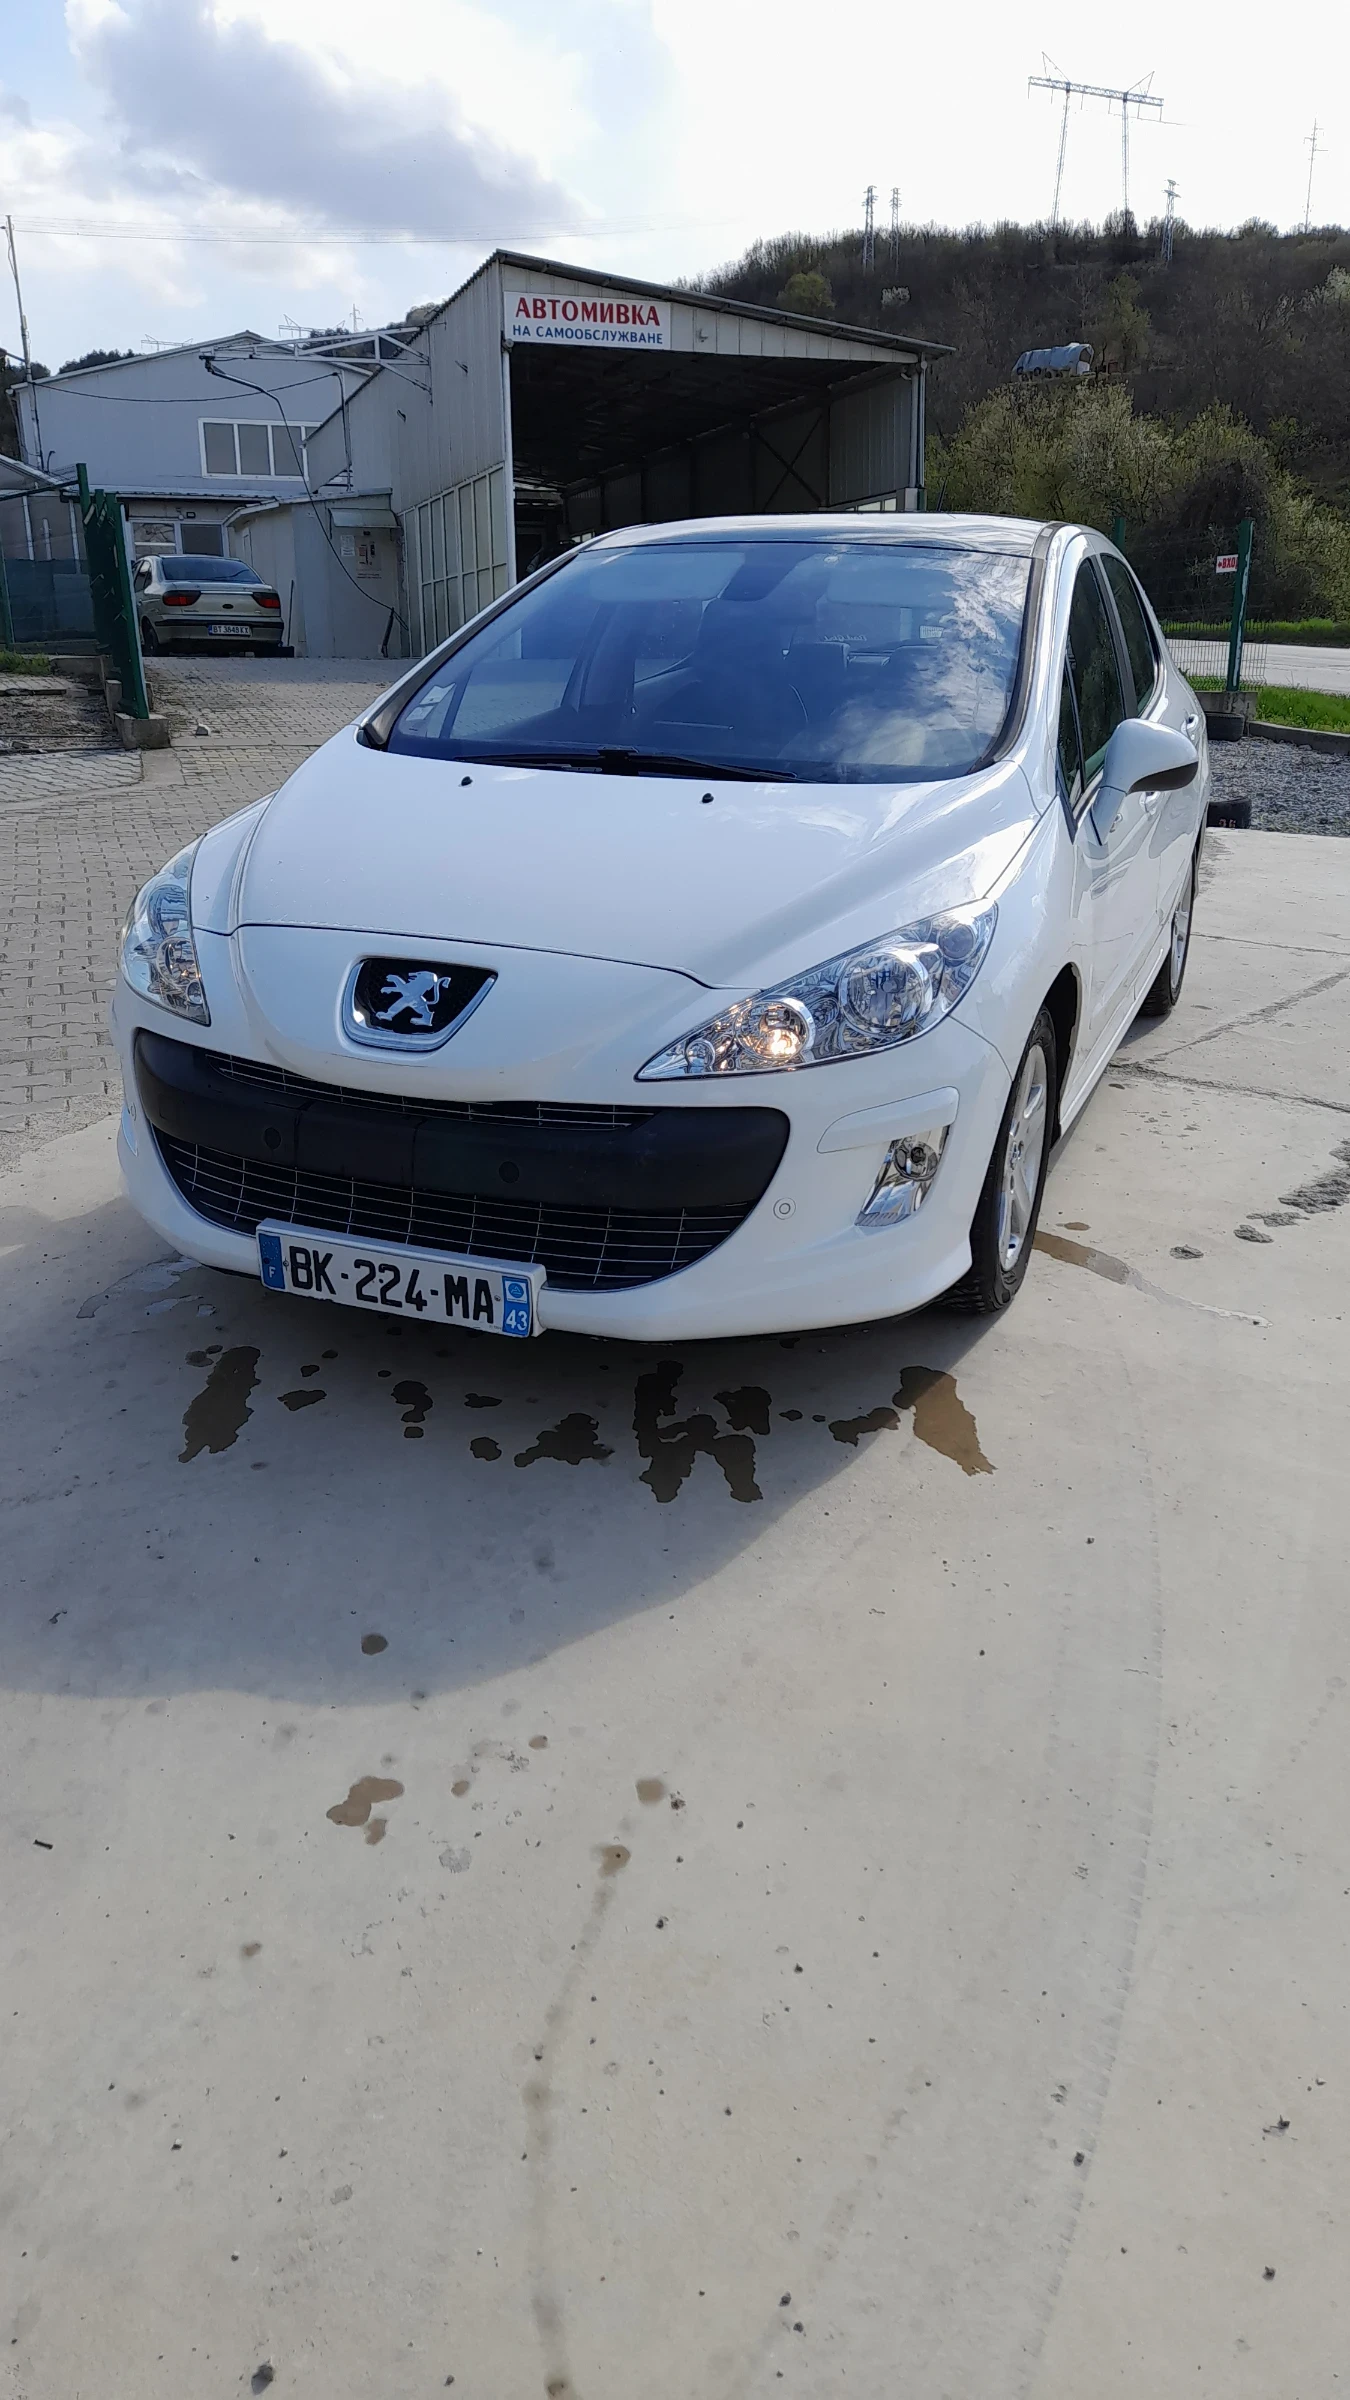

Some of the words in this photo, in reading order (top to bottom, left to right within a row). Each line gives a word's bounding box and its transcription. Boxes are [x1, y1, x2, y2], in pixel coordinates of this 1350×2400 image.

[515, 297, 660, 327] АВТОМИВКА
[513, 325, 531, 337] НА
[536, 326, 663, 344] САМООБСЛУЖВАНЕ
[268, 1266, 276, 1278] F
[288, 1245, 494, 1325] BK-224-MA
[505, 1309, 528, 1331] 43
